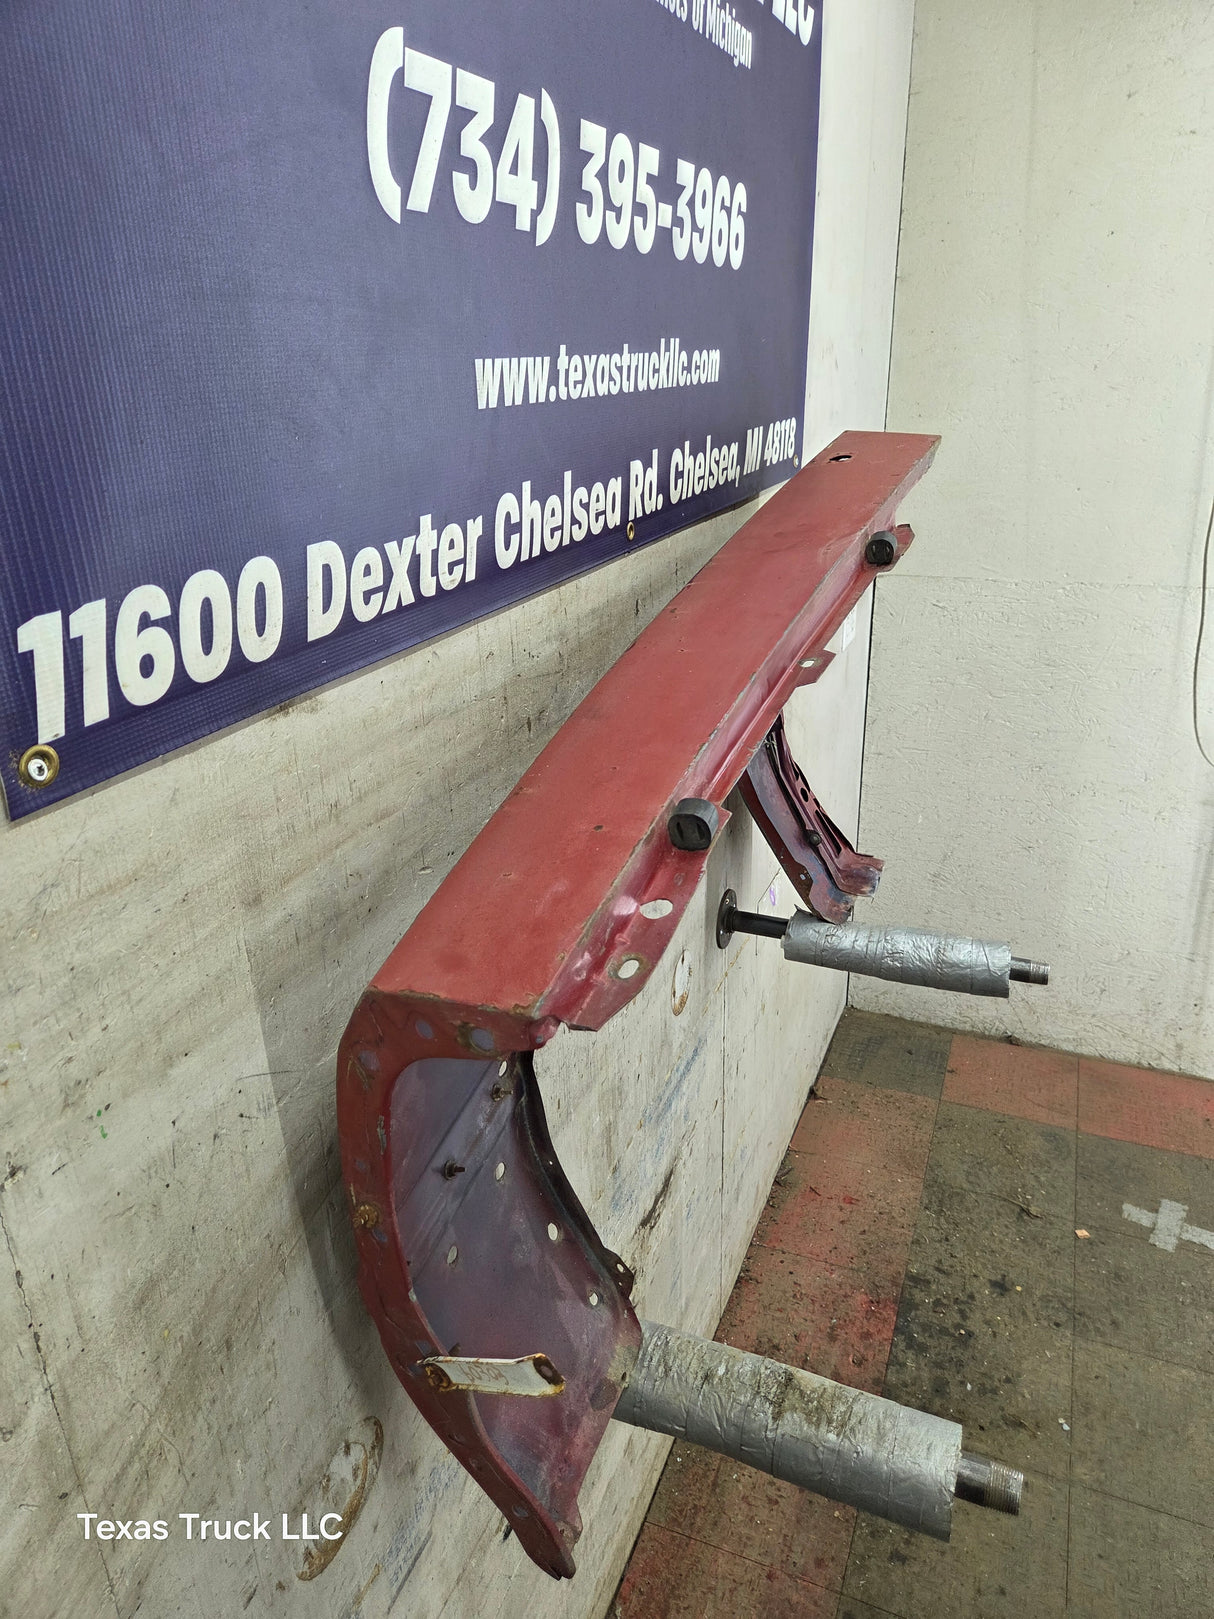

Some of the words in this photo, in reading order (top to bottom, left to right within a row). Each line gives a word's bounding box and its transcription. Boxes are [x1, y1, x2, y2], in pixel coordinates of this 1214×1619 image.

[706, 0, 752, 69] Michigan
[367, 26, 560, 246] (734)
[576, 119, 747, 270] 395-3966
[475, 338, 720, 410] www.texastruckllc.com
[16, 555, 284, 744] 11600
[306, 514, 483, 642] Dexter
[495, 471, 622, 570] Chelsea
[628, 448, 664, 521] Rd.
[669, 434, 741, 505] Chelsea,
[744, 425, 764, 476] MI
[763, 417, 797, 467] 48118
